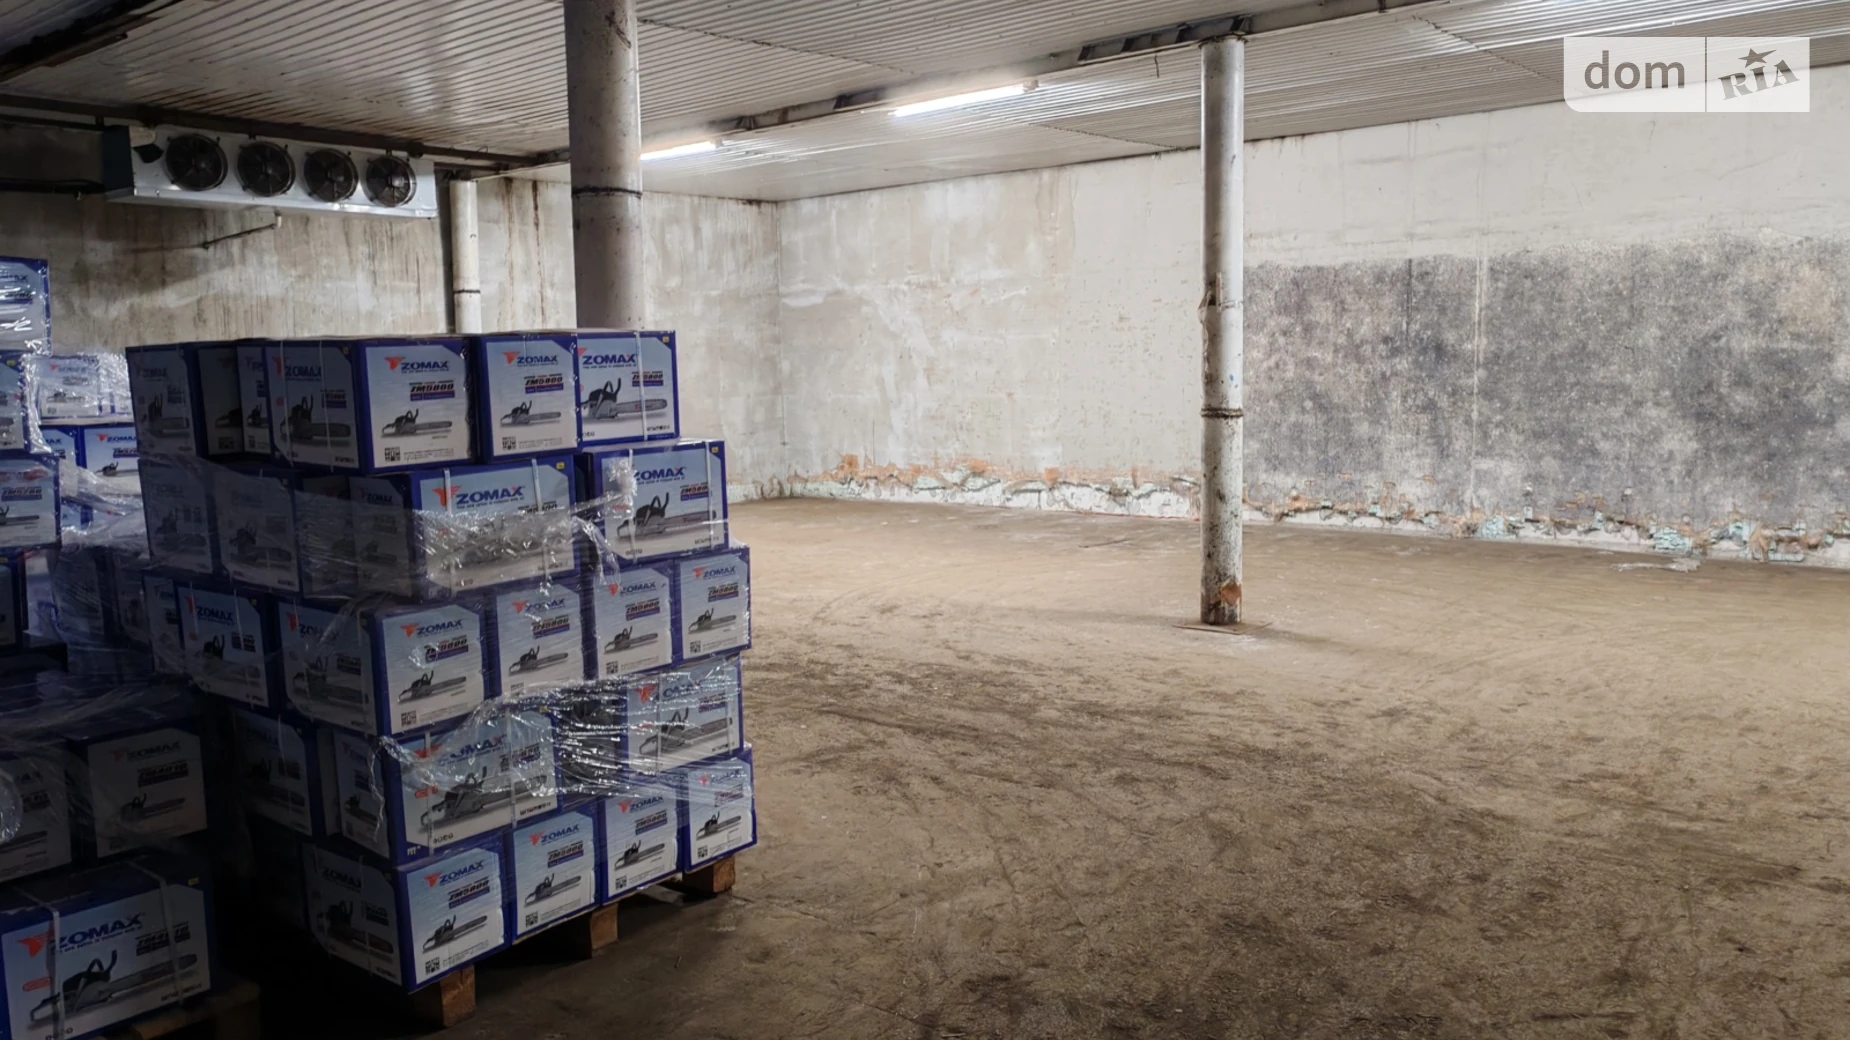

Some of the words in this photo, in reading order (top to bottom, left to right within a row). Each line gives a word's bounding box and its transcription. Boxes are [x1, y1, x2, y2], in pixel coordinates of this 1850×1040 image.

[402, 360, 448, 371] ZOMAX
[517, 354, 558, 364] ZOMAX
[583, 354, 636, 365] ZOMAX
[107, 434, 136, 442] ZOMA
[634, 466, 685, 481] ZOMAX
[456, 486, 523, 505] ZOMAX
[703, 566, 735, 578] ZOMAX
[620, 581, 656, 595] ZOMAX
[197, 605, 233, 622] ZOMAX
[417, 619, 463, 636] ZOMAX
[629, 796, 663, 812] ZOMAX
[540, 824, 580, 845] ZOMAX
[439, 859, 485, 884] ZOMAX
[59, 913, 143, 948] ZOMAX
